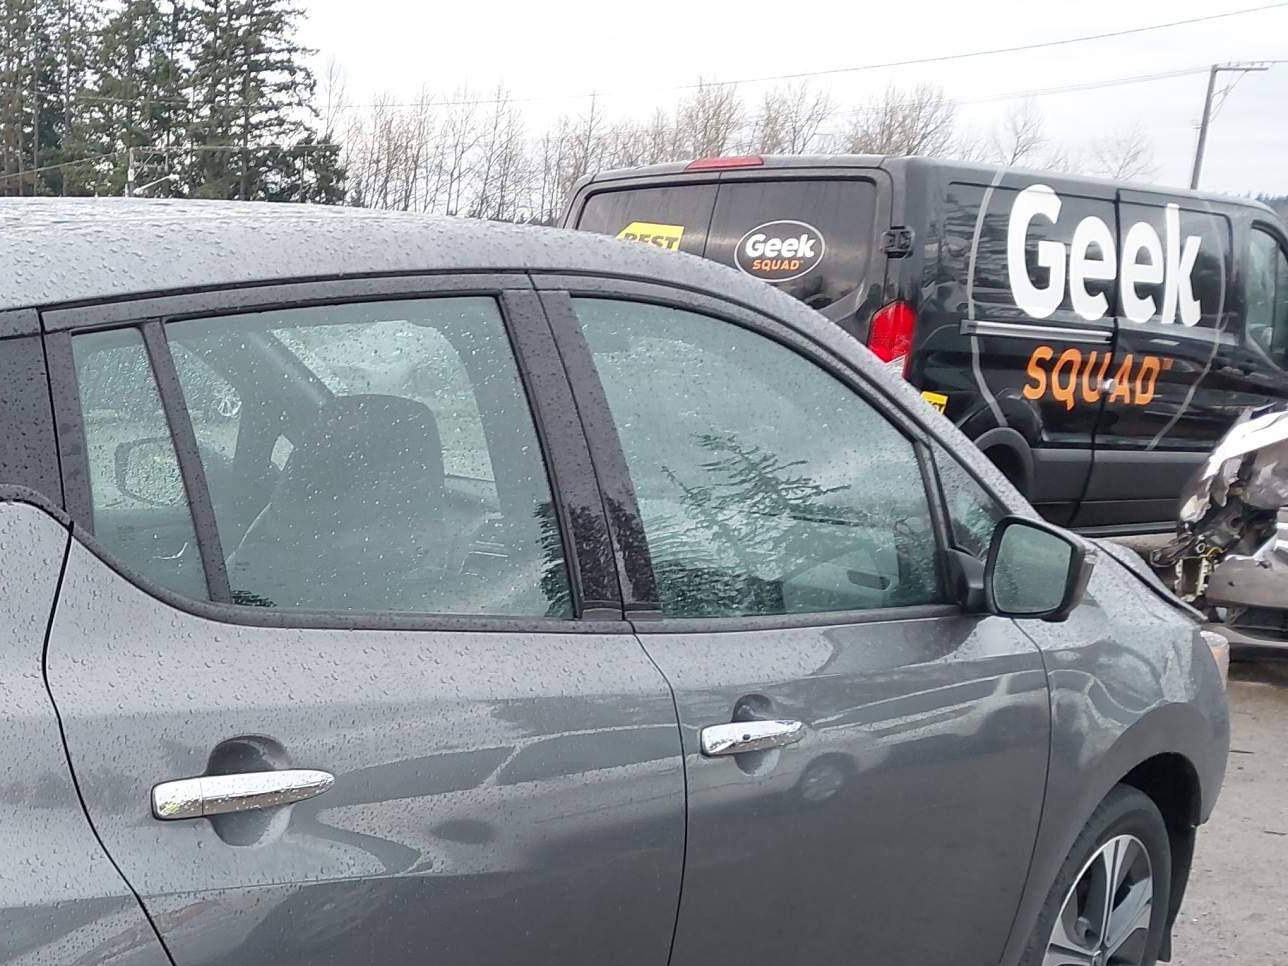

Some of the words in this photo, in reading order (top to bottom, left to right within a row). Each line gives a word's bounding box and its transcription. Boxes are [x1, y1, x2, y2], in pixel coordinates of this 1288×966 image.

[745, 233, 816, 258] Geek
[1007, 184, 1202, 327] Geek
[752, 259, 800, 271] SQUAD
